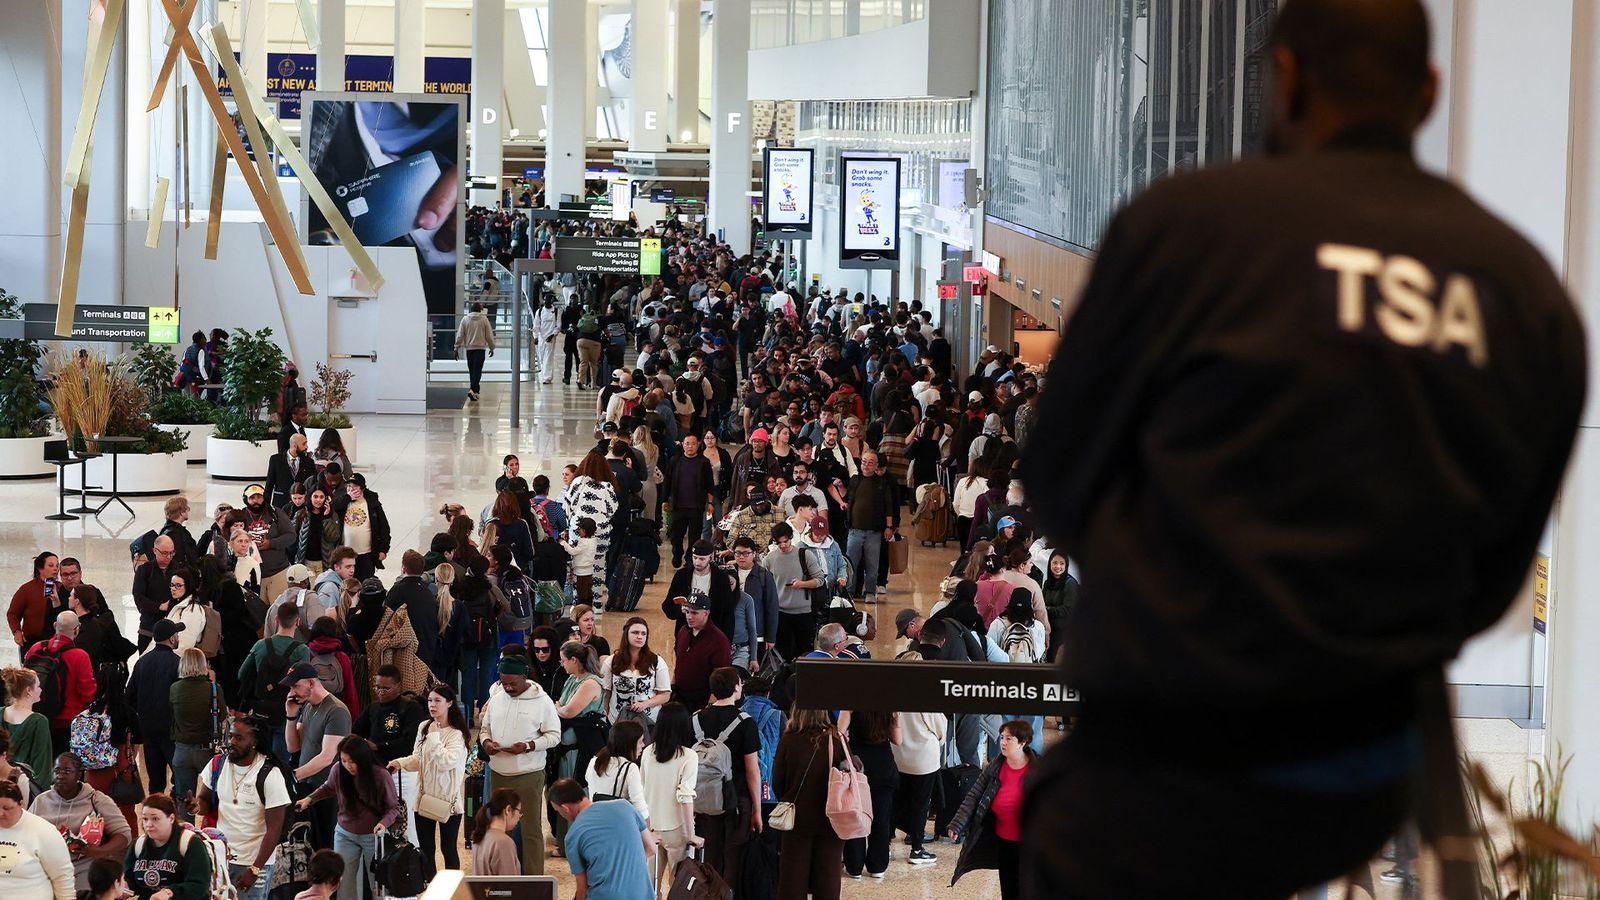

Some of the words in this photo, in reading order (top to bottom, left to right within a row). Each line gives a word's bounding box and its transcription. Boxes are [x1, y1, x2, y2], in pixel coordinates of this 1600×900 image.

[282, 78, 306, 90] NEW
[354, 80, 393, 92] TERMIN
[482, 108, 496, 124] D
[645, 111, 656, 130] E
[728, 113, 740, 134] F
[1316, 242, 1489, 368] TSA
[83, 310, 121, 319] Terminals
[88, 328, 146, 337] Transportation
[940, 680, 1038, 699] Terminals
[1045, 686, 1058, 700] A
